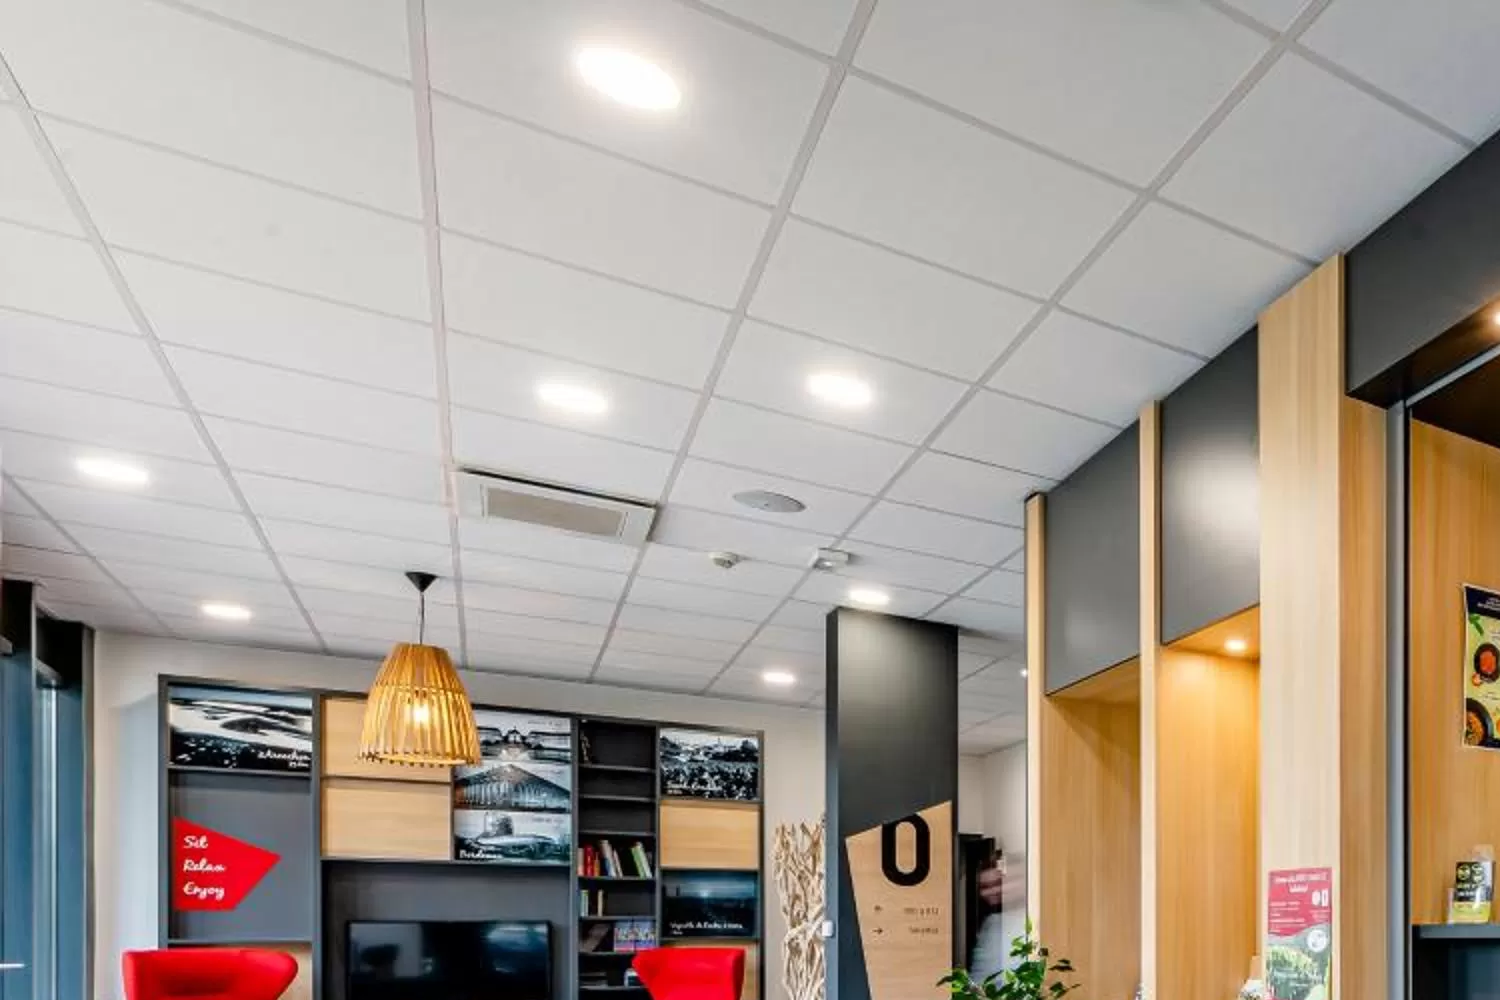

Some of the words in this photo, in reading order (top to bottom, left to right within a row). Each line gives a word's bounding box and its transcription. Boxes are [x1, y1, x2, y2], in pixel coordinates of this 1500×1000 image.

[183, 835, 208, 849] Sit
[183, 857, 227, 873] Relax
[183, 881, 225, 902] Enjoy
